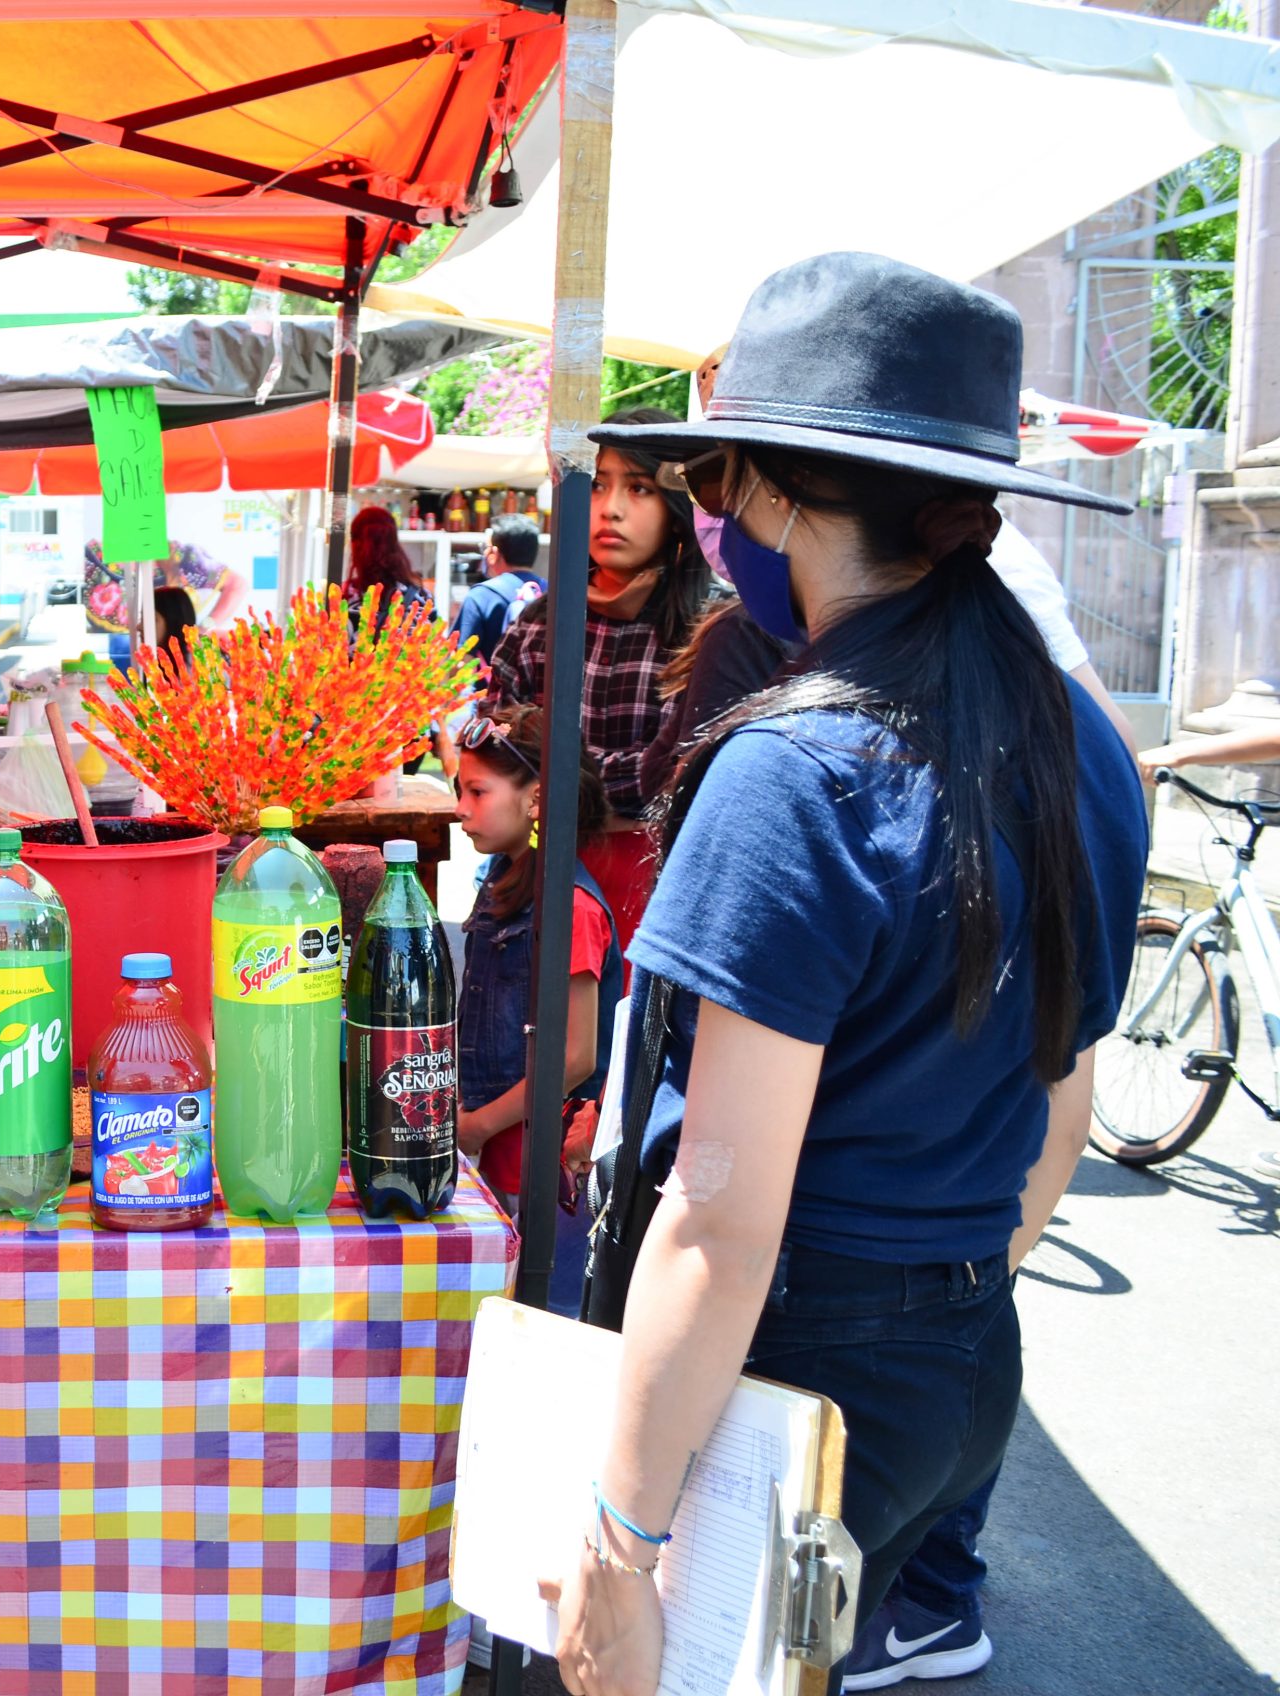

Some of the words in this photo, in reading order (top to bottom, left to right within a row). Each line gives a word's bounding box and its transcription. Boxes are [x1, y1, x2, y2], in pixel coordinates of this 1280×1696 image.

[239, 945, 292, 996] Squirt
[403, 1046, 451, 1071] sangría
[97, 1104, 174, 1142] Clamato
[111, 1135, 122, 1145] EL
[123, 1126, 159, 1141] ORIGINAL
[135, 1197, 155, 1205] TOMATE
[154, 1196, 166, 1204] CON
[166, 1196, 174, 1204] UN
[174, 1194, 191, 1205] TOQUE
[190, 1194, 198, 1202] DE
